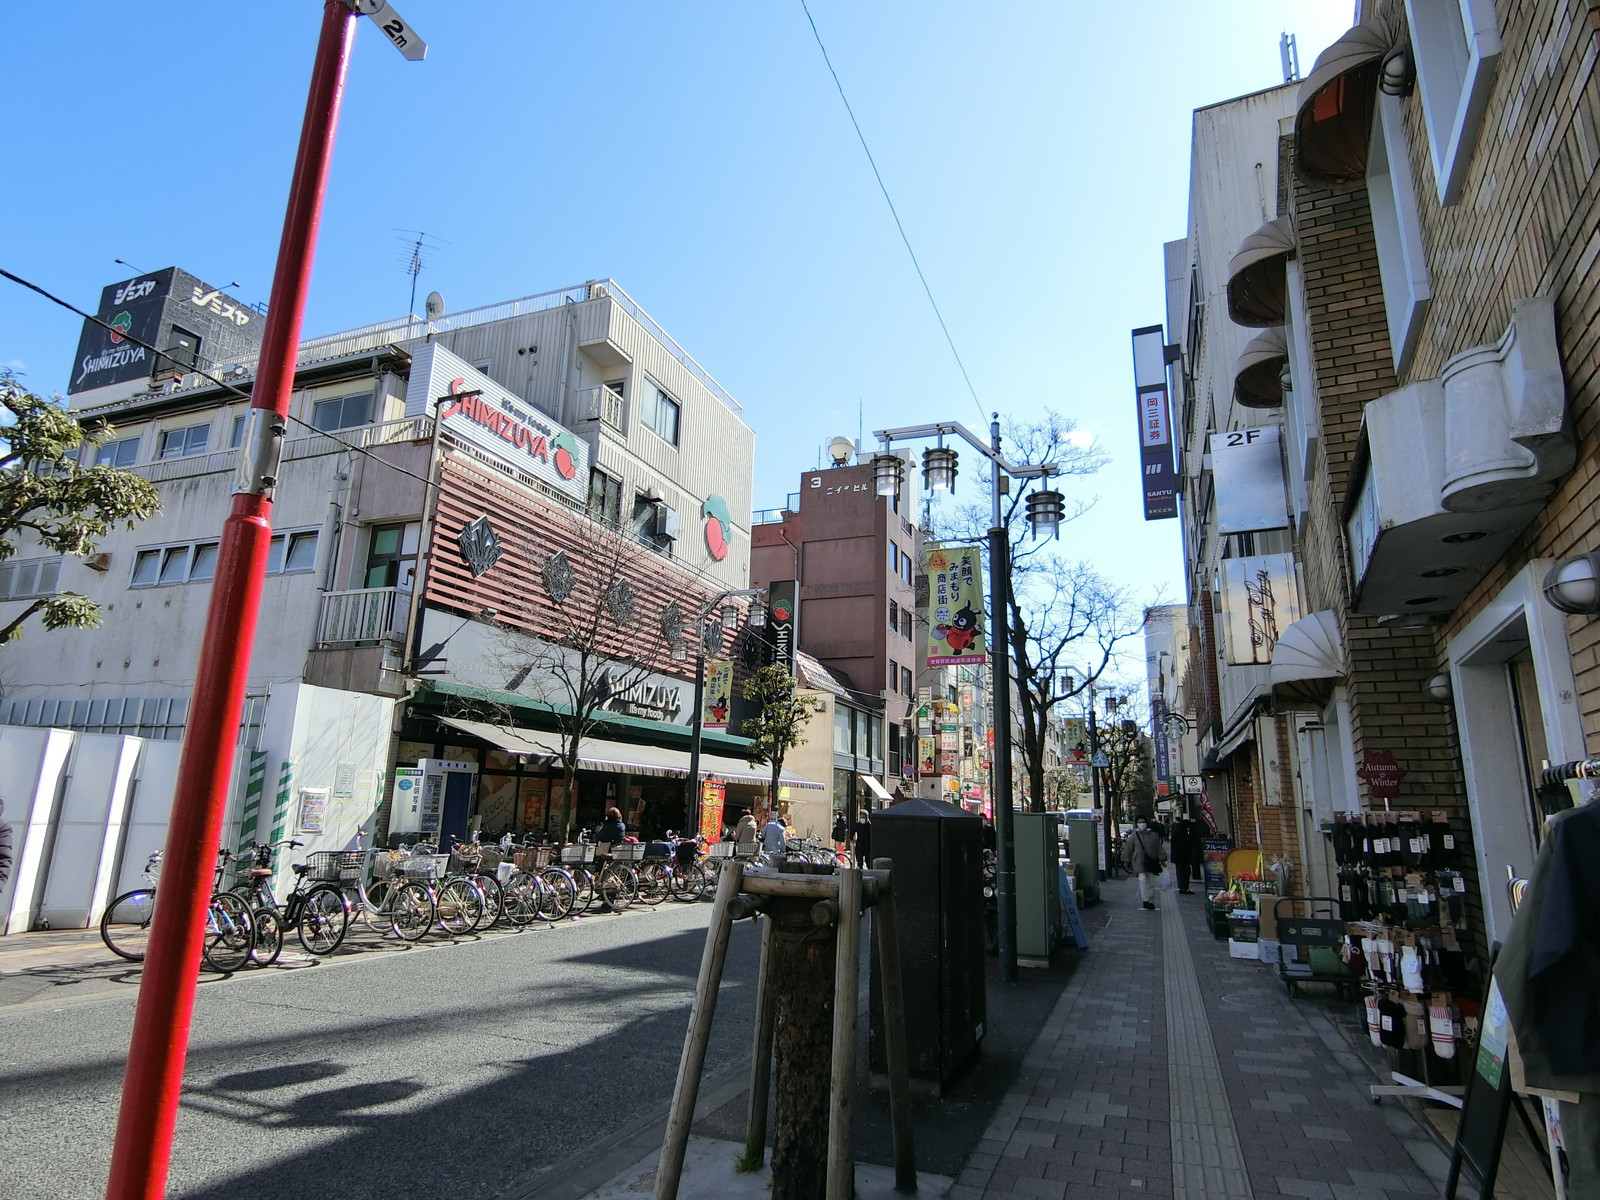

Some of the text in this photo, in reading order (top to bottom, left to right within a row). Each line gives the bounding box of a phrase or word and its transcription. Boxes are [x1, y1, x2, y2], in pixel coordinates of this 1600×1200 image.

[382, 19, 408, 48] 2m
[113, 279, 157, 305] シミズヤ
[191, 286, 250, 326] シミズヤ
[76, 346, 146, 385] SHIMIZUYA
[442, 377, 549, 463] SHIMIZUYA
[1226, 429, 1261, 447] 2F
[1146, 490, 1172, 498] SANYU
[948, 562, 960, 603] みまもり
[961, 555, 973, 586] 笑顔で
[936, 573, 948, 605] 商店街
[602, 666, 683, 712] SHIMIZUYA
[1365, 763, 1397, 771] Autumn
[1370, 778, 1398, 786] Winter
